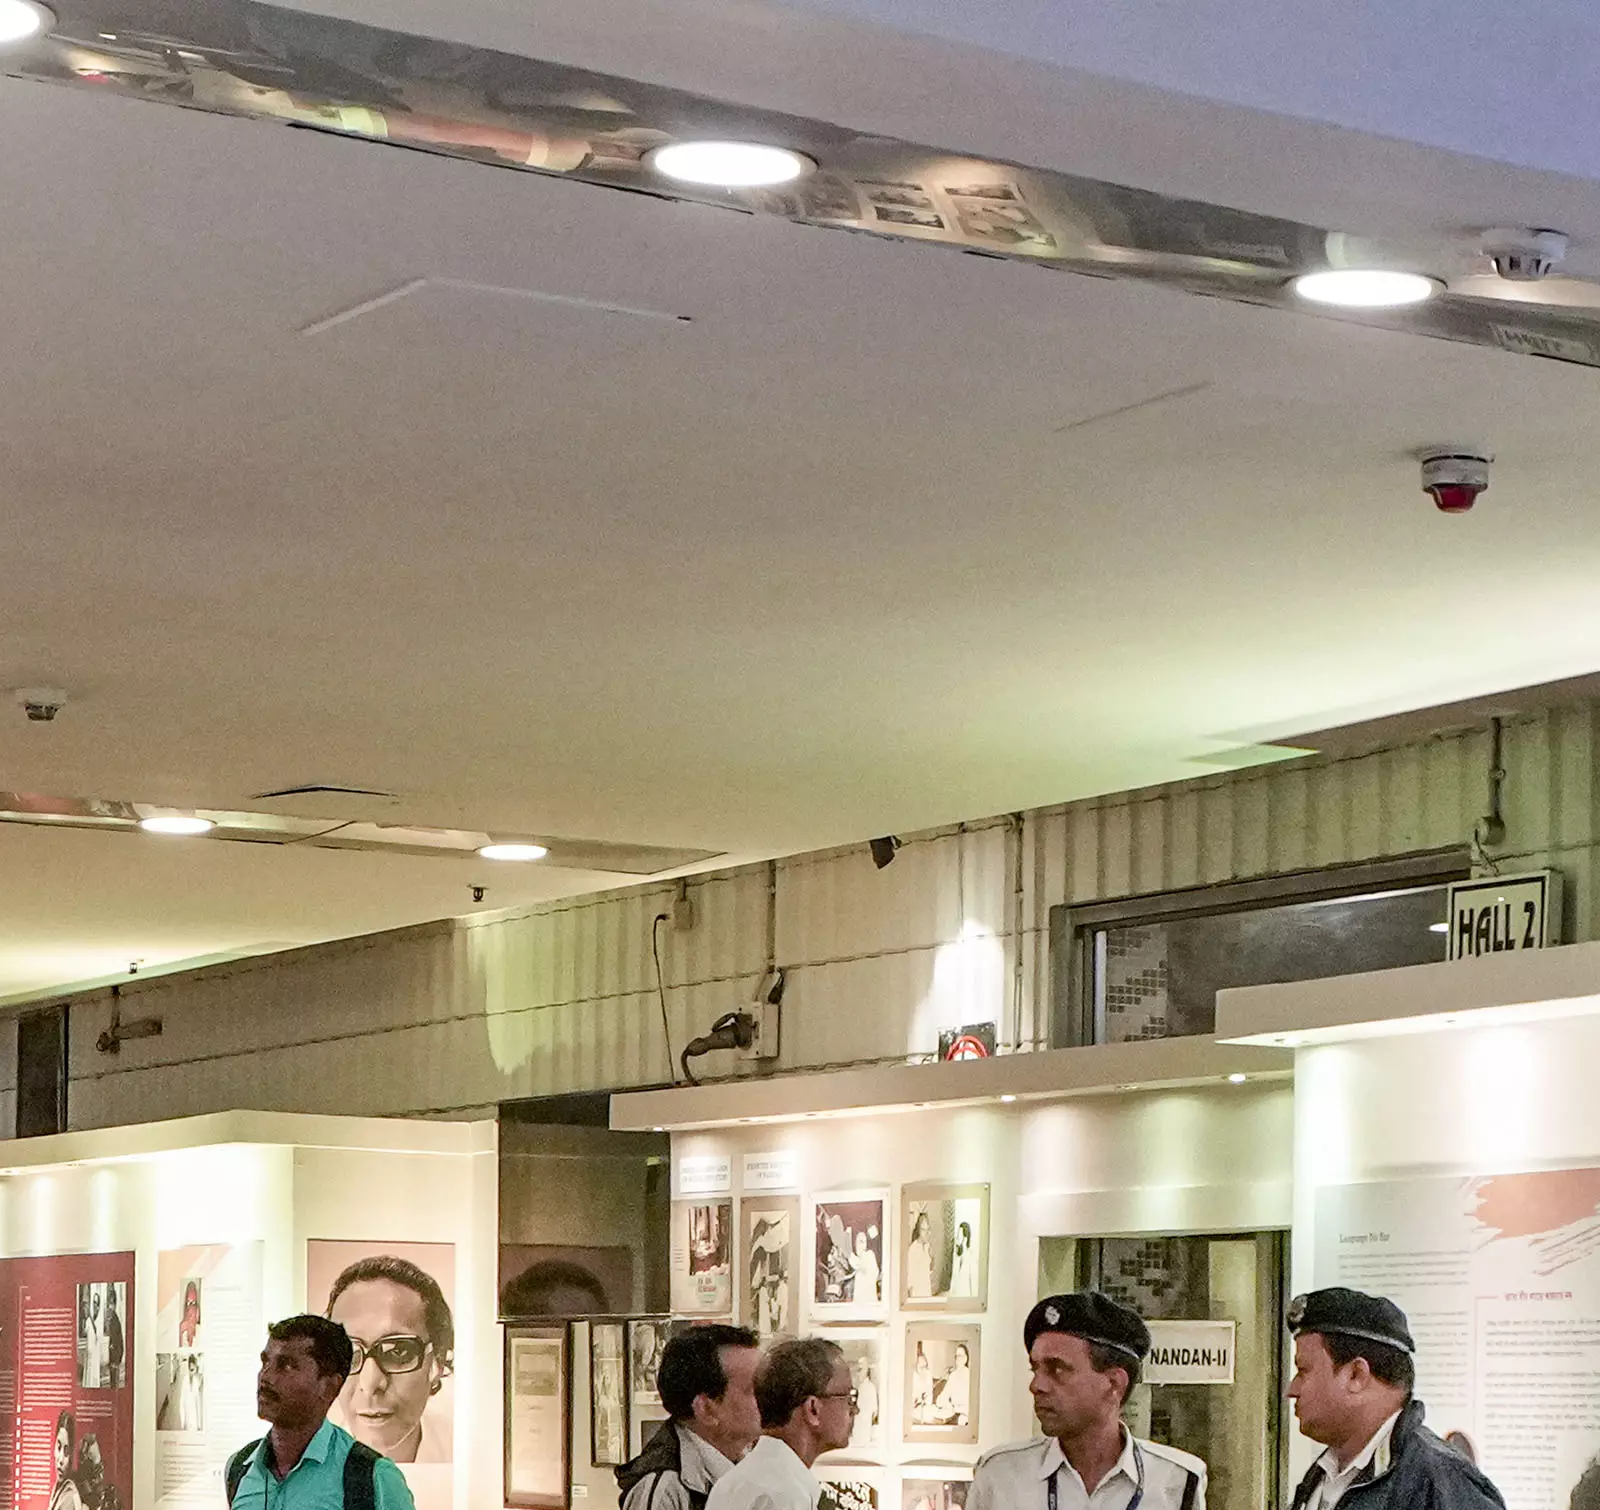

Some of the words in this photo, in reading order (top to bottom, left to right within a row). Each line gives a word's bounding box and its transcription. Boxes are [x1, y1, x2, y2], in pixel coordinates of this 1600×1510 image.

[1458, 904, 1516, 958] HALL
[1522, 901, 1536, 949] 2
[1150, 1348, 1227, 1367] NANDAN-II
